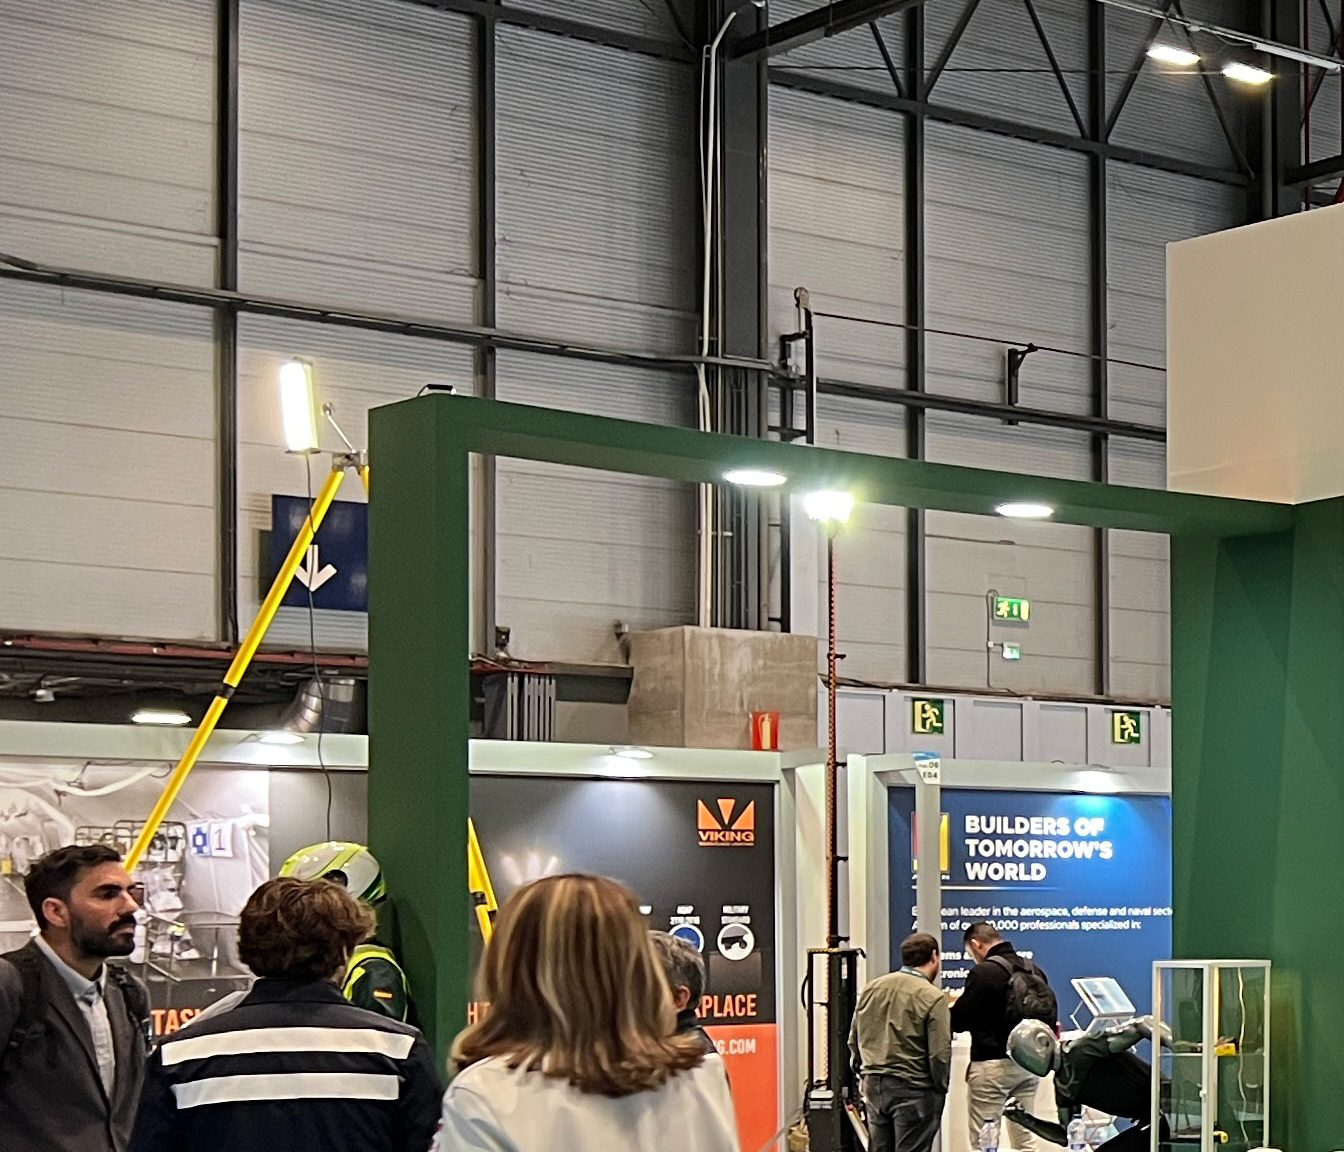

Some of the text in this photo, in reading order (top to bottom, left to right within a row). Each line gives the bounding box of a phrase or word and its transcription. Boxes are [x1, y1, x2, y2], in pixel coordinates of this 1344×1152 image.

[965, 815, 1104, 837] BUILDERS OF
[699, 831, 754, 841] VIKING
[965, 839, 1113, 860] TOMORROW'S
[965, 862, 1046, 881] WORLD
[911, 906, 1173, 918] Eean leader in the aerospace, defense and naval sect
[949, 920, 961, 931] of
[1020, 920, 1080, 932] professionals
[1081, 920, 1130, 931] specialized
[694, 995, 757, 1018] PLACE
[716, 1038, 756, 1054] G.COM
